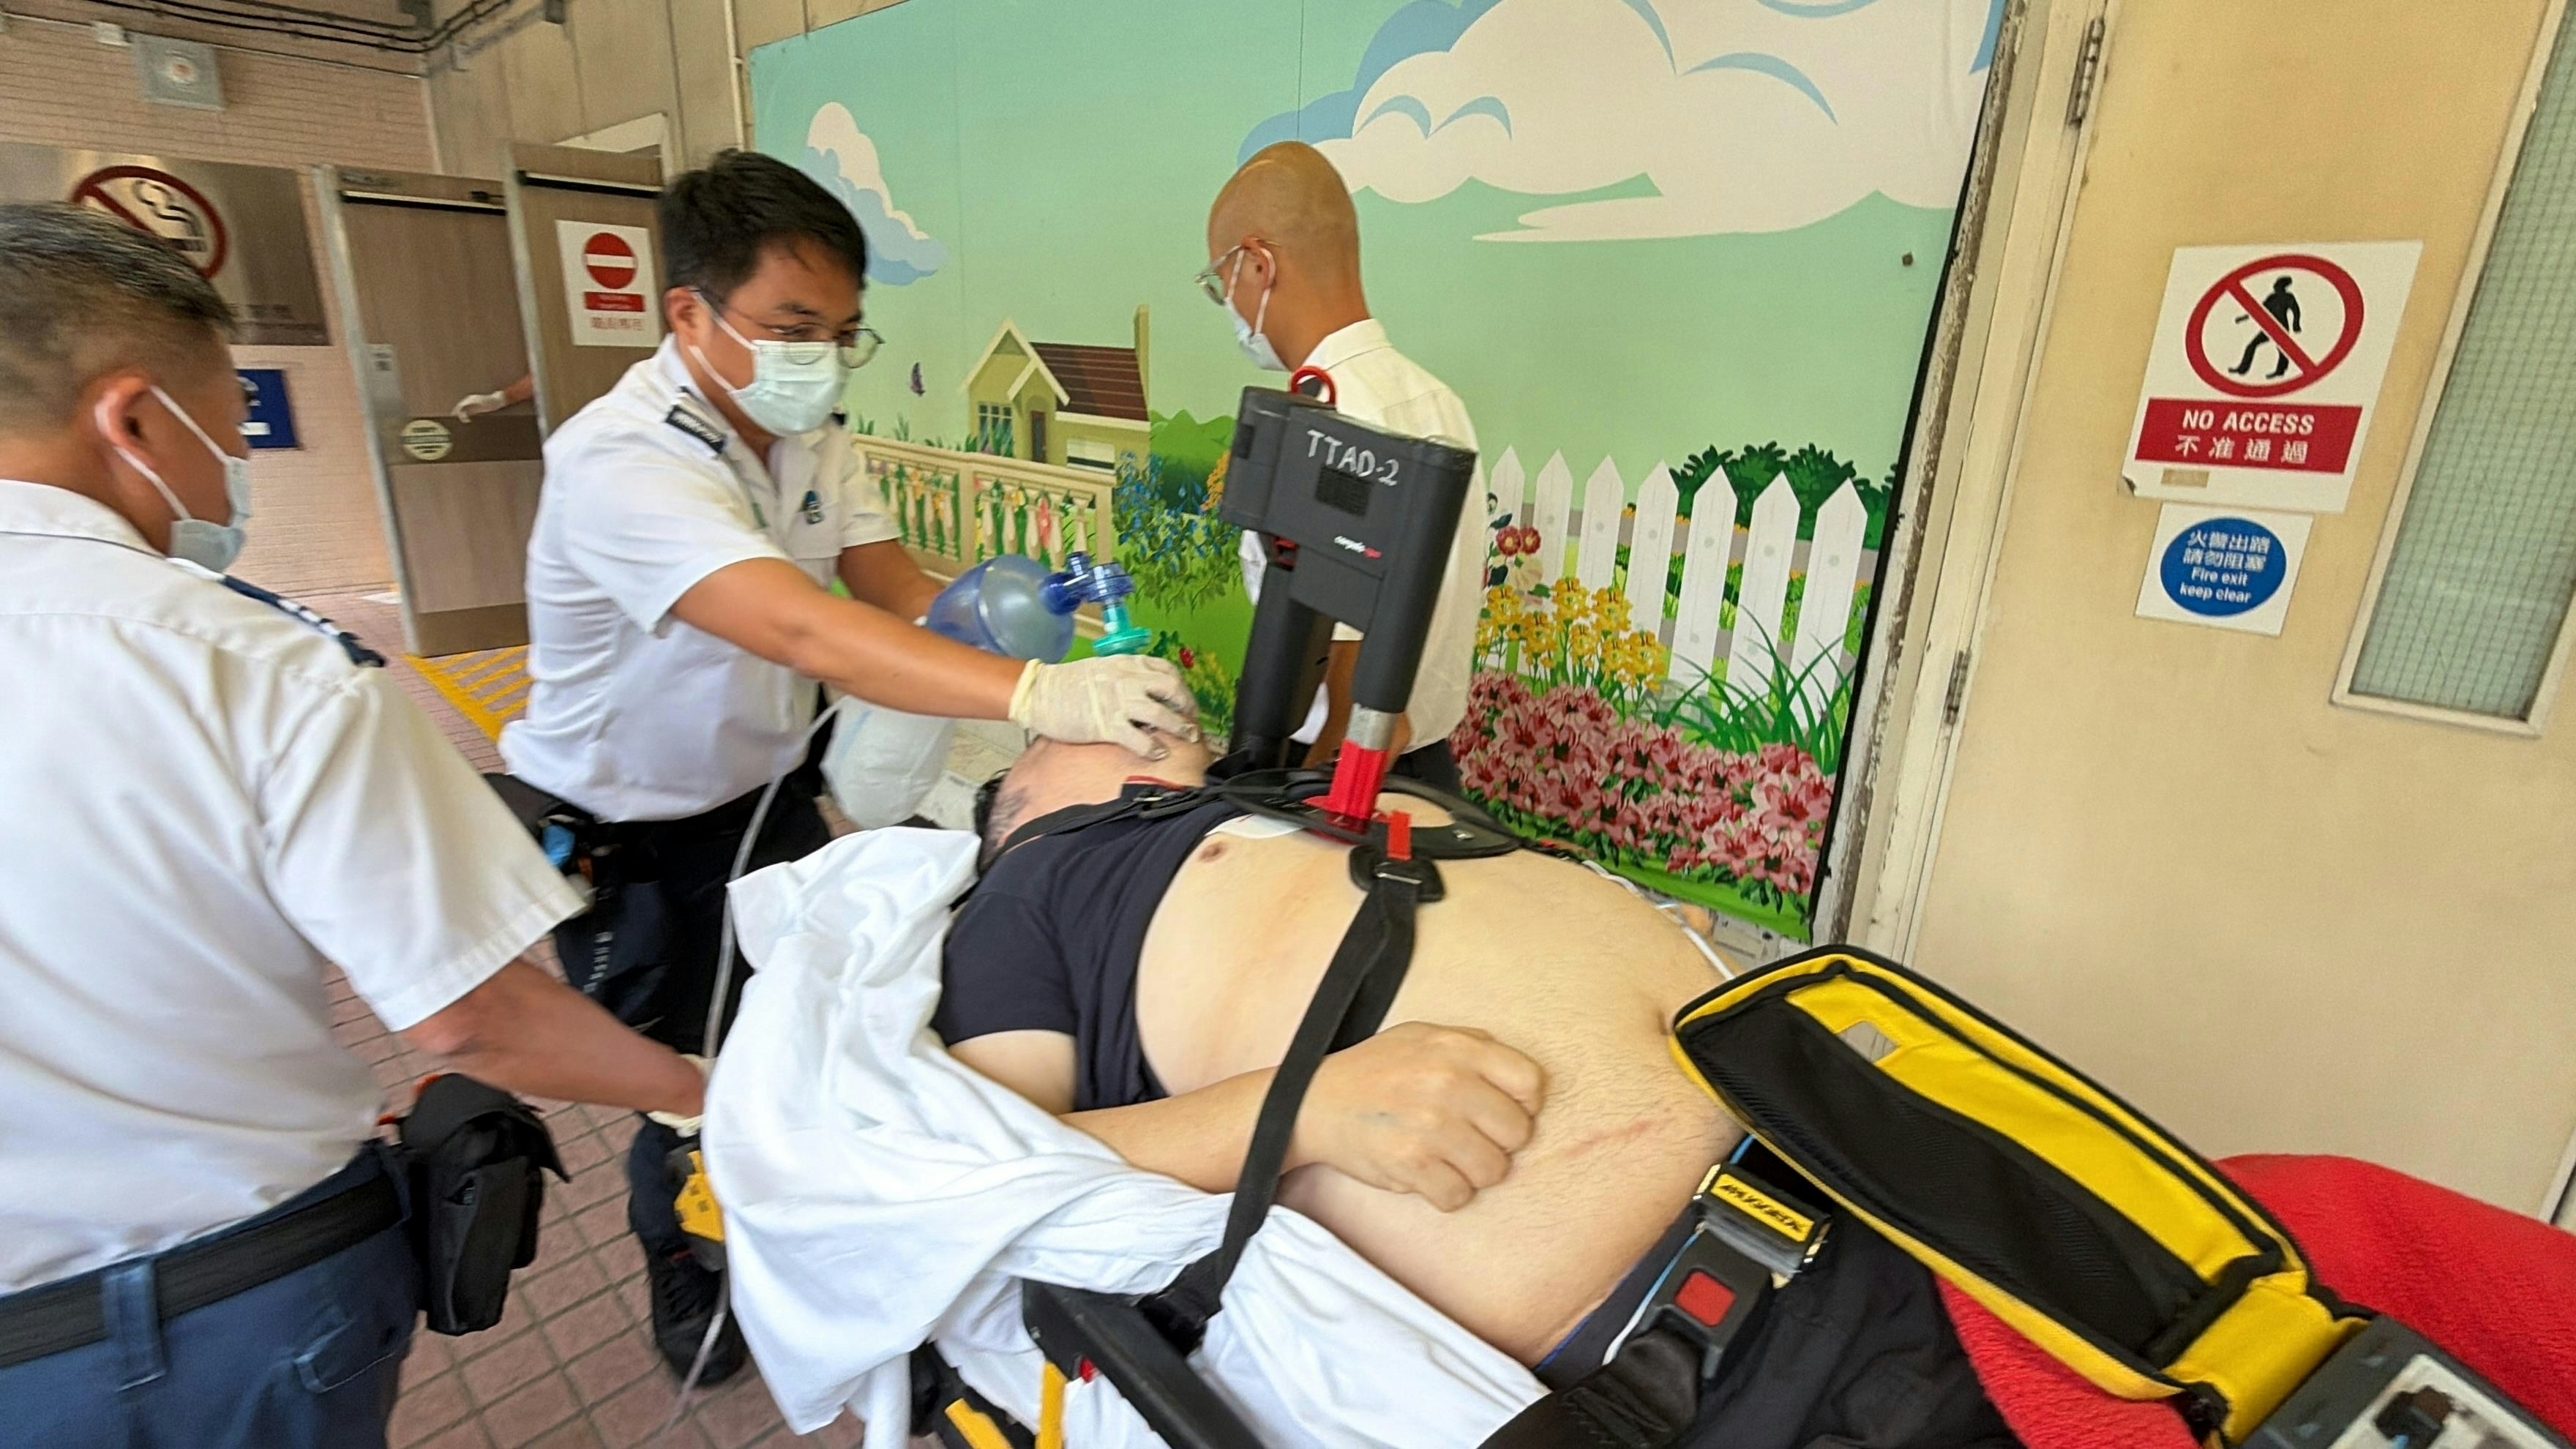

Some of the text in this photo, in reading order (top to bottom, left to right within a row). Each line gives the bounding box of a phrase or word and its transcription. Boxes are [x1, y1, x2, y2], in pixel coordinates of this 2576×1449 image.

[2182, 408, 2315, 435] NO ACCESS
[1306, 429, 1400, 487] TTAD-2
[2174, 434, 2309, 465] 不准通過
[2187, 530, 2271, 554] 火警出路
[2182, 547, 2266, 572] 請勿阻塞
[2191, 566, 2248, 587] Fire exit
[2179, 582, 2252, 603] keep clear
